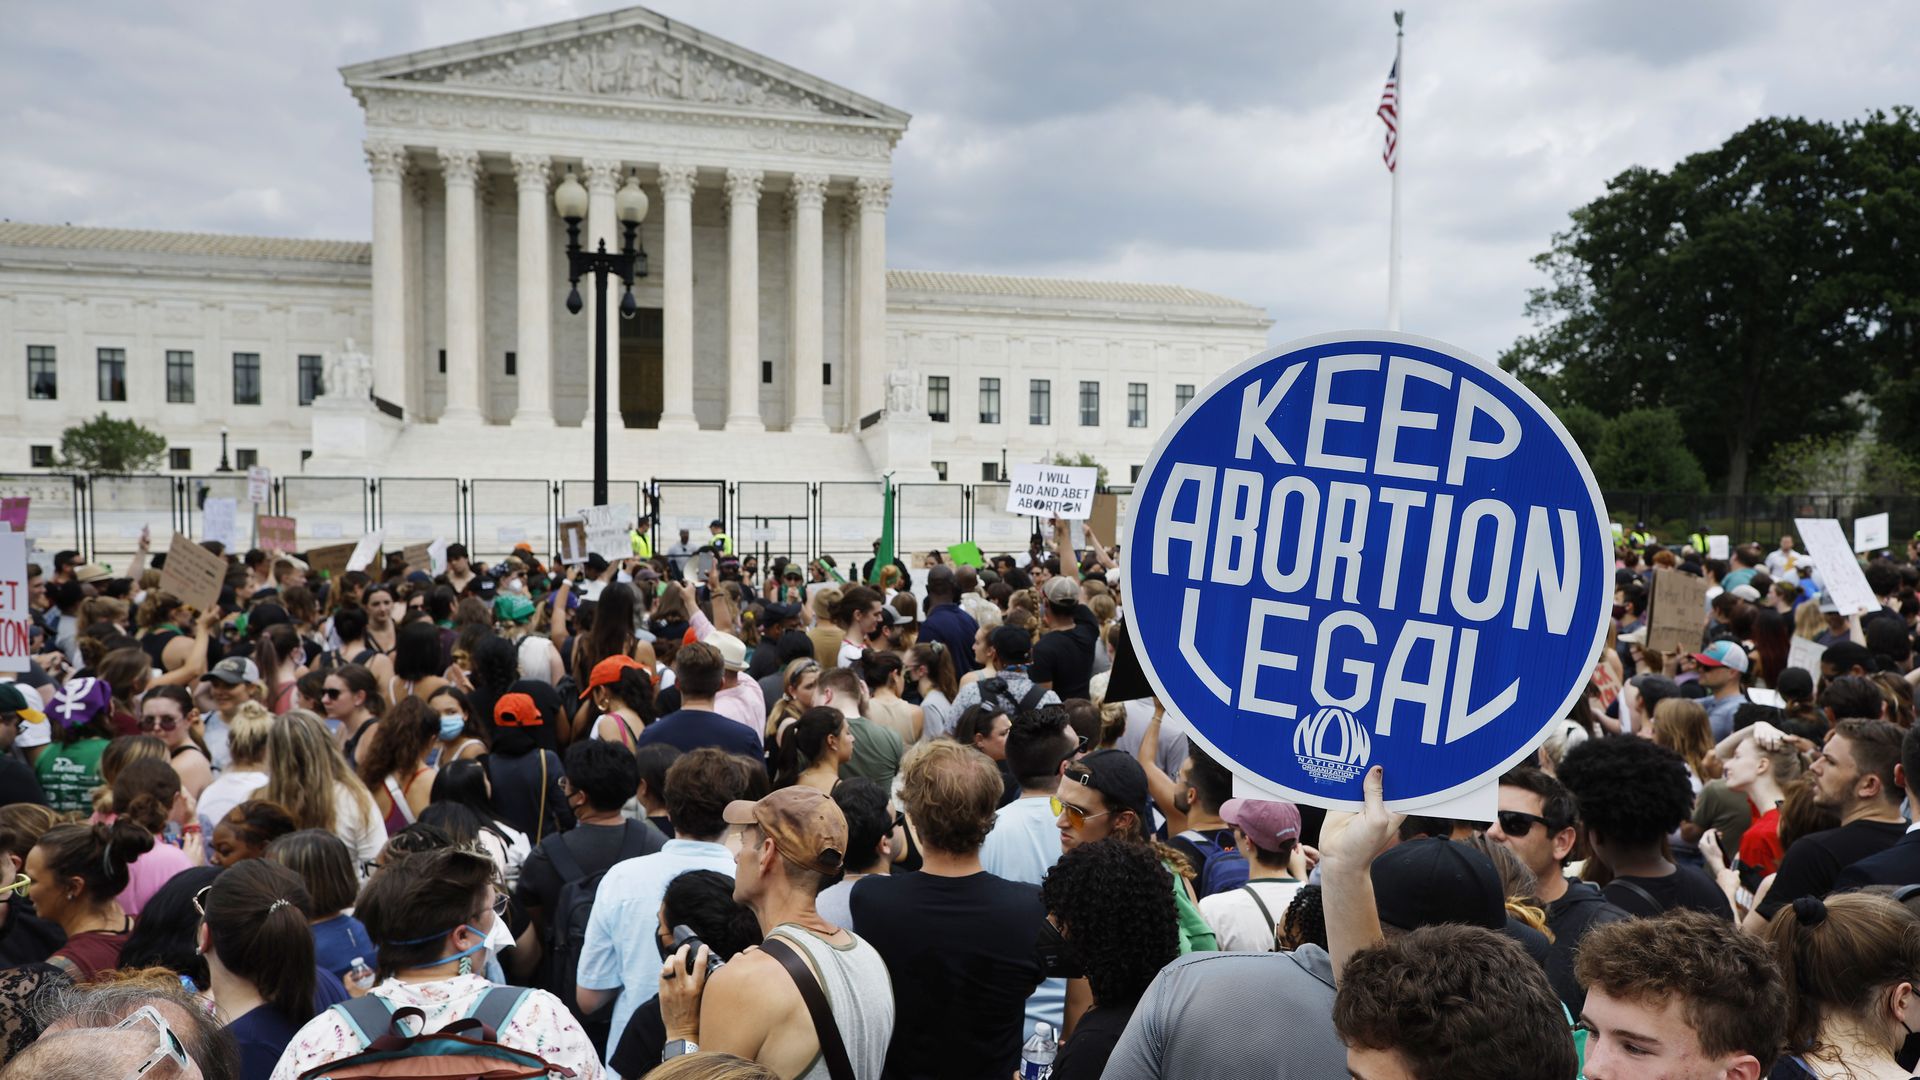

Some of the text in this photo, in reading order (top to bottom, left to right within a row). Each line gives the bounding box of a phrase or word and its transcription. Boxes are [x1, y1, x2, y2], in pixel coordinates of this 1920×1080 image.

[1235, 353, 1523, 486] KEEP
[1038, 471, 1071, 484] I WILL
[1015, 483, 1090, 499] AID AND ABET
[1017, 497, 1082, 513] ABORTION
[1151, 462, 1581, 636] ABORTION
[1178, 587, 1520, 746] LEGAL
[1293, 708, 1371, 767] NOW
[1297, 756, 1361, 774] NATIONAL
[1302, 764, 1354, 779] ORGANIZATION
